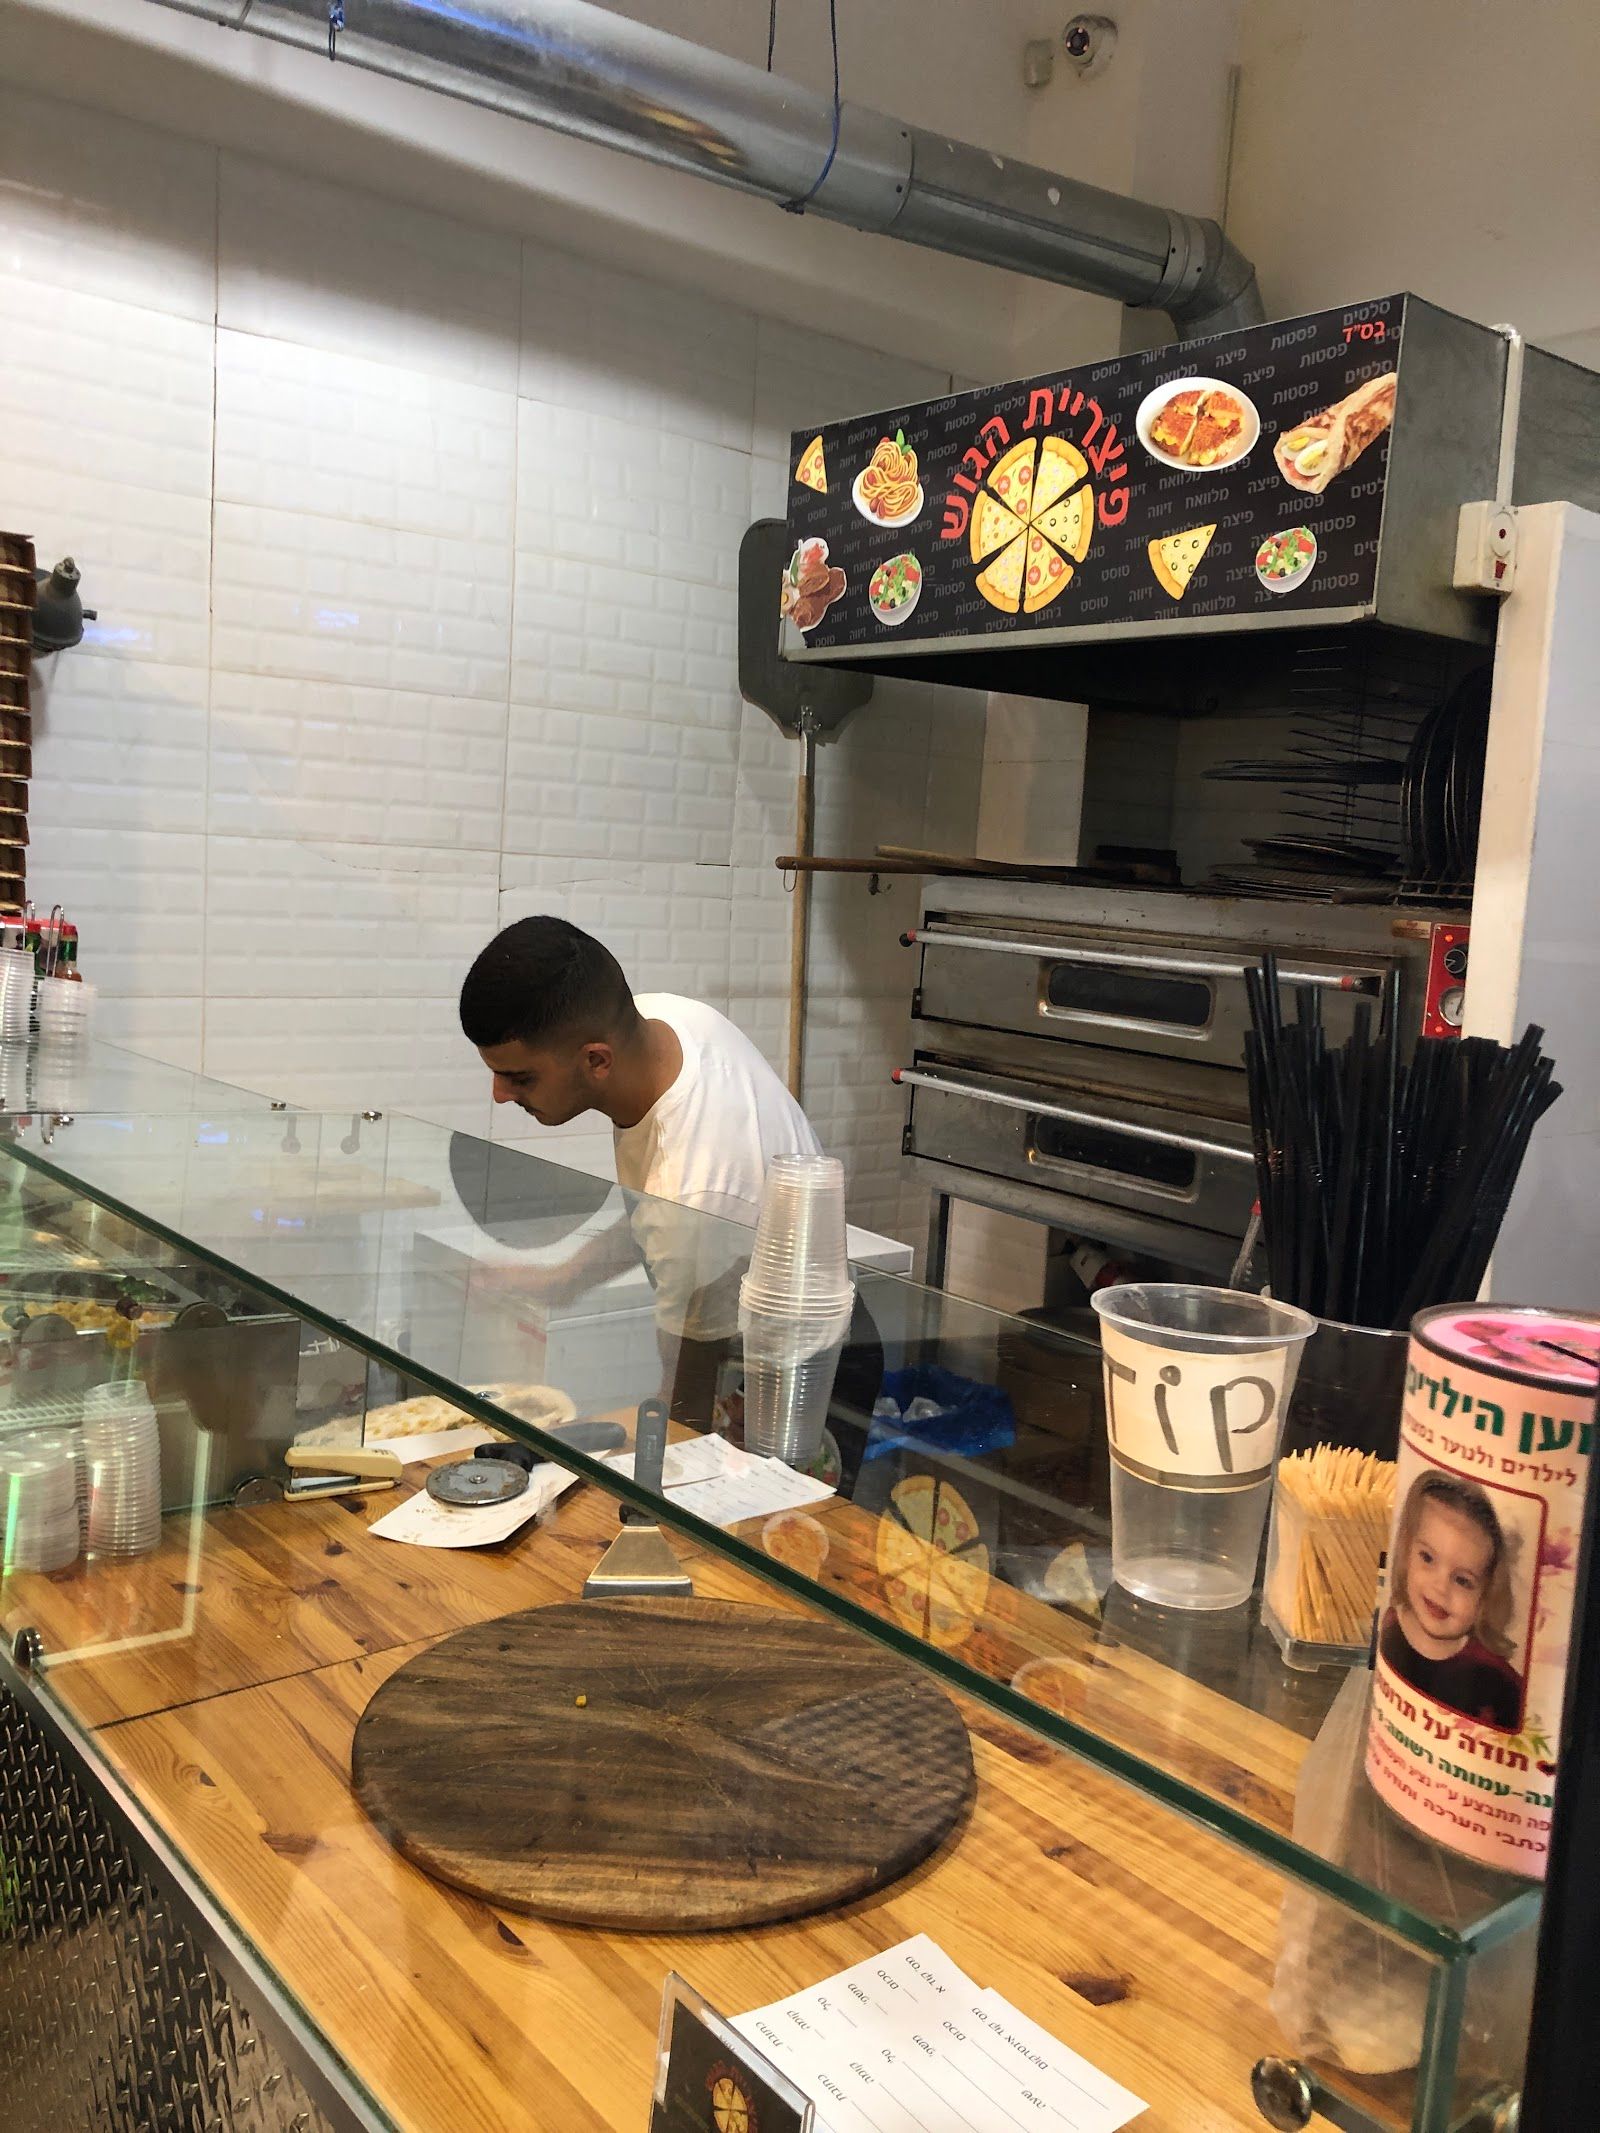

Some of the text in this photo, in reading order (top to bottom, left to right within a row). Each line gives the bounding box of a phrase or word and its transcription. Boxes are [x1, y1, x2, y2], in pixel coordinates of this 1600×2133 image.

[1270, 324, 1317, 351] פסטות
[1215, 348, 1247, 369] פיצה
[1300, 342, 1348, 369] פסטות
[1092, 363, 1121, 382] טוסט
[1154, 363, 1198, 387] מלוואח
[1243, 365, 1275, 386] פיצה
[1344, 359, 1393, 385] סלטים
[1118, 380, 1142, 399] זיווה
[1272, 381, 1319, 405] פסטות
[926, 398, 957, 417] פסטות
[994, 395, 1025, 415] סלטים
[945, 412, 977, 432] פסטות
[926, 442, 958, 460] פסטות
[940, 387, 1130, 540] פיצריית הגוש
[1247, 475, 1280, 495] פיצה
[1185, 487, 1230, 509] מלוואח
[1277, 494, 1325, 516] פסטות
[1147, 501, 1173, 519] זיווה
[1222, 510, 1254, 530] פיצה
[911, 520, 933, 535] פיצה
[1309, 515, 1357, 536] פסטות
[1101, 564, 1130, 581] טוסט
[1311, 572, 1360, 593] פסטות
[934, 581, 966, 599] פסטות
[1128, 586, 1153, 603] זיווה
[955, 598, 986, 616] פסטות
[1080, 596, 1108, 612] טוסט
[1154, 605, 1180, 621] זיווה
[1192, 595, 1236, 615] מלוואח
[917, 611, 939, 625] פיצה
[985, 616, 1017, 633] סלטים
[1034, 606, 1062, 624] ג'חנון
[1441, 1435, 1494, 1468] ולנוער
[1501, 1458, 1577, 1487] לילדים
[1423, 1709, 1450, 1740] על
[1458, 1732, 1528, 1772] תודה
[1423, 1798, 1487, 1836] הערכה
[877, 1969, 899, 1990] סכום
[786, 2009, 811, 2031] קומה
[755, 2021, 783, 2048] כתובת
[942, 2020, 967, 2042] סכום
[849, 2061, 875, 2084] קומה
[817, 2073, 848, 2102] כתובת
